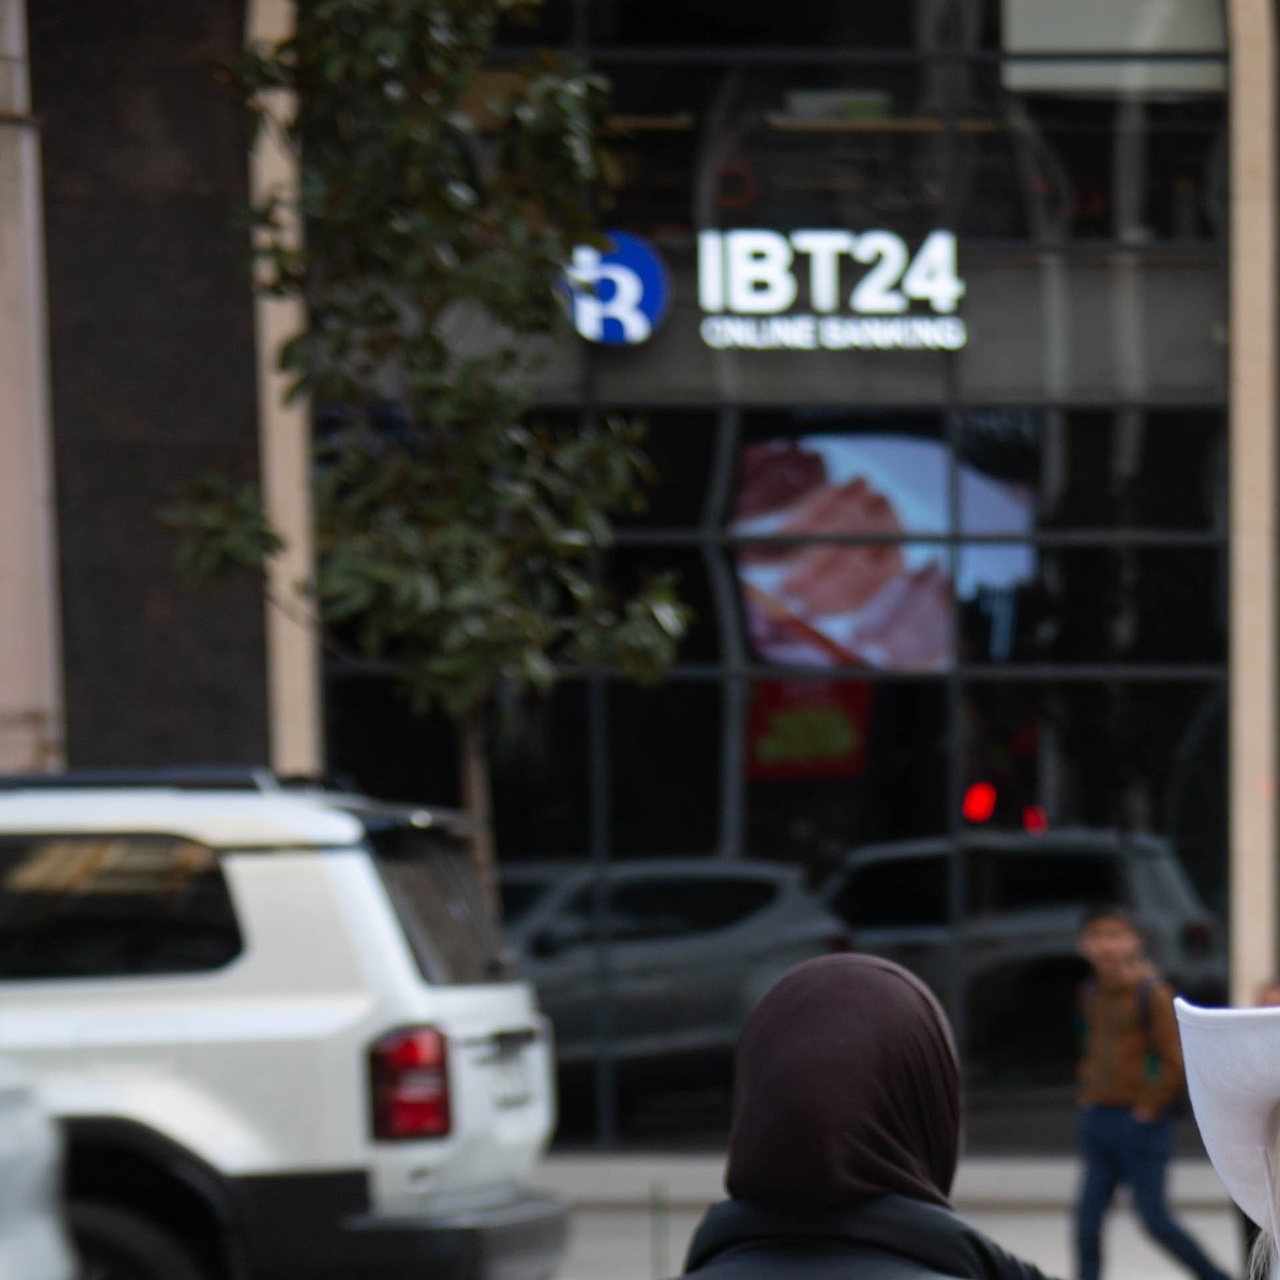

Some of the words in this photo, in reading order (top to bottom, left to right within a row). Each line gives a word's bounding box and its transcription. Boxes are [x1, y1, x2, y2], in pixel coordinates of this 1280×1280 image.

[699, 229, 965, 313] IBT24
[701, 315, 817, 349] ONLINE
[819, 315, 967, 350] BANKING
